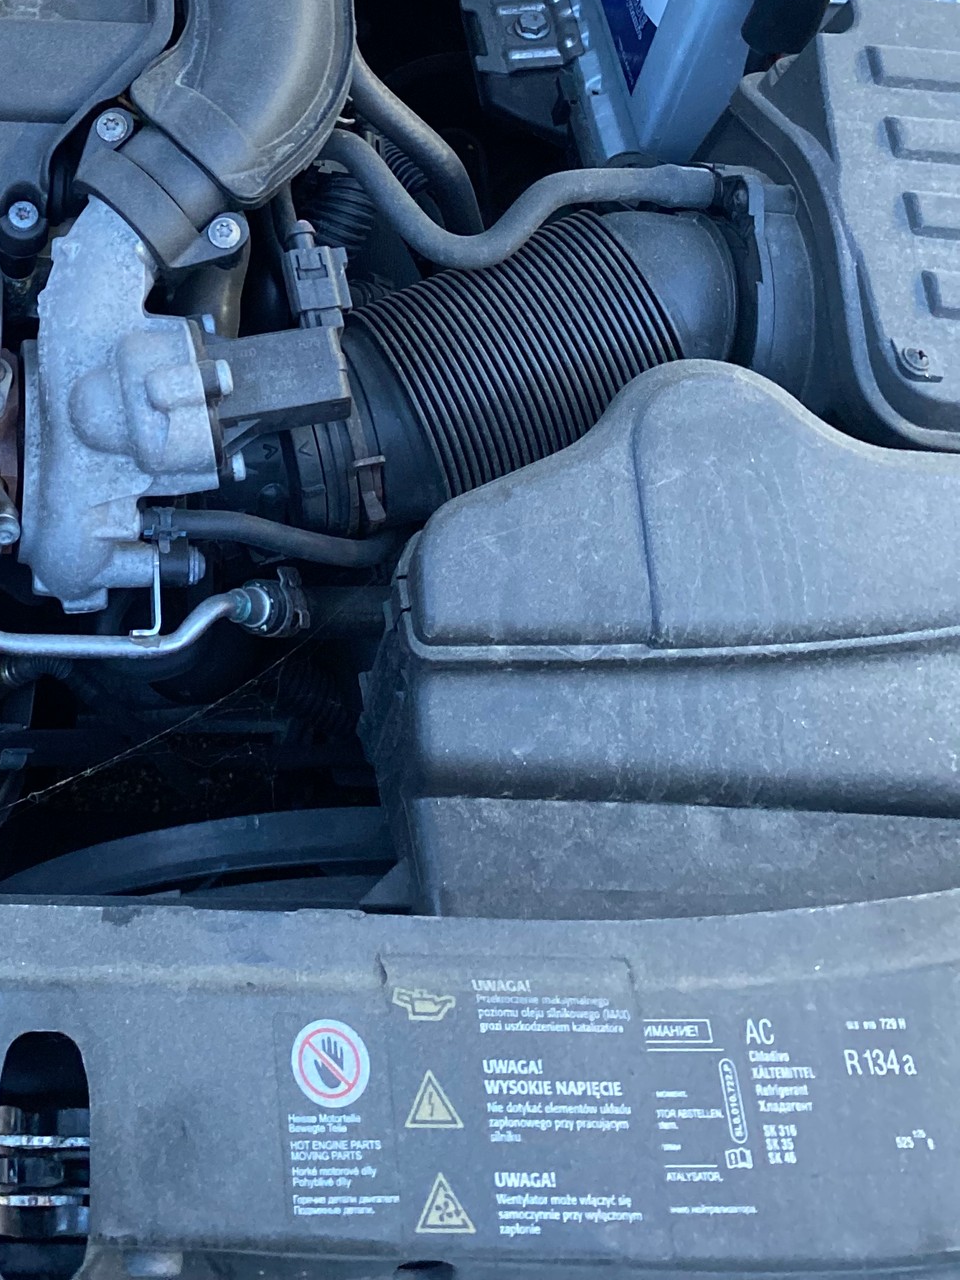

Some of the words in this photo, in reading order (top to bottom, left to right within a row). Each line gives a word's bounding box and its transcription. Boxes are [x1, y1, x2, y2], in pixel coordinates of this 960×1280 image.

[472, 979, 531, 992] UWAGA!
[746, 1018, 775, 1045] AC
[483, 1059, 543, 1074] UWAGA!
[484, 1080, 553, 1095] WYSOKIE
[555, 1081, 623, 1099] NAPIĘCIE
[486, 1102, 504, 1113] Nie
[554, 1119, 574, 1131] przy
[290, 1140, 310, 1150] HOT
[311, 1140, 349, 1150] ENGINE
[350, 1140, 382, 1150] PARTS
[290, 1151, 330, 1161] MOVING
[331, 1151, 363, 1161] PARTS
[494, 1172, 557, 1188] UWAGA!
[551, 1194, 577, 1205] może
[618, 1194, 632, 1207] się
[562, 1211, 583, 1223] przy
